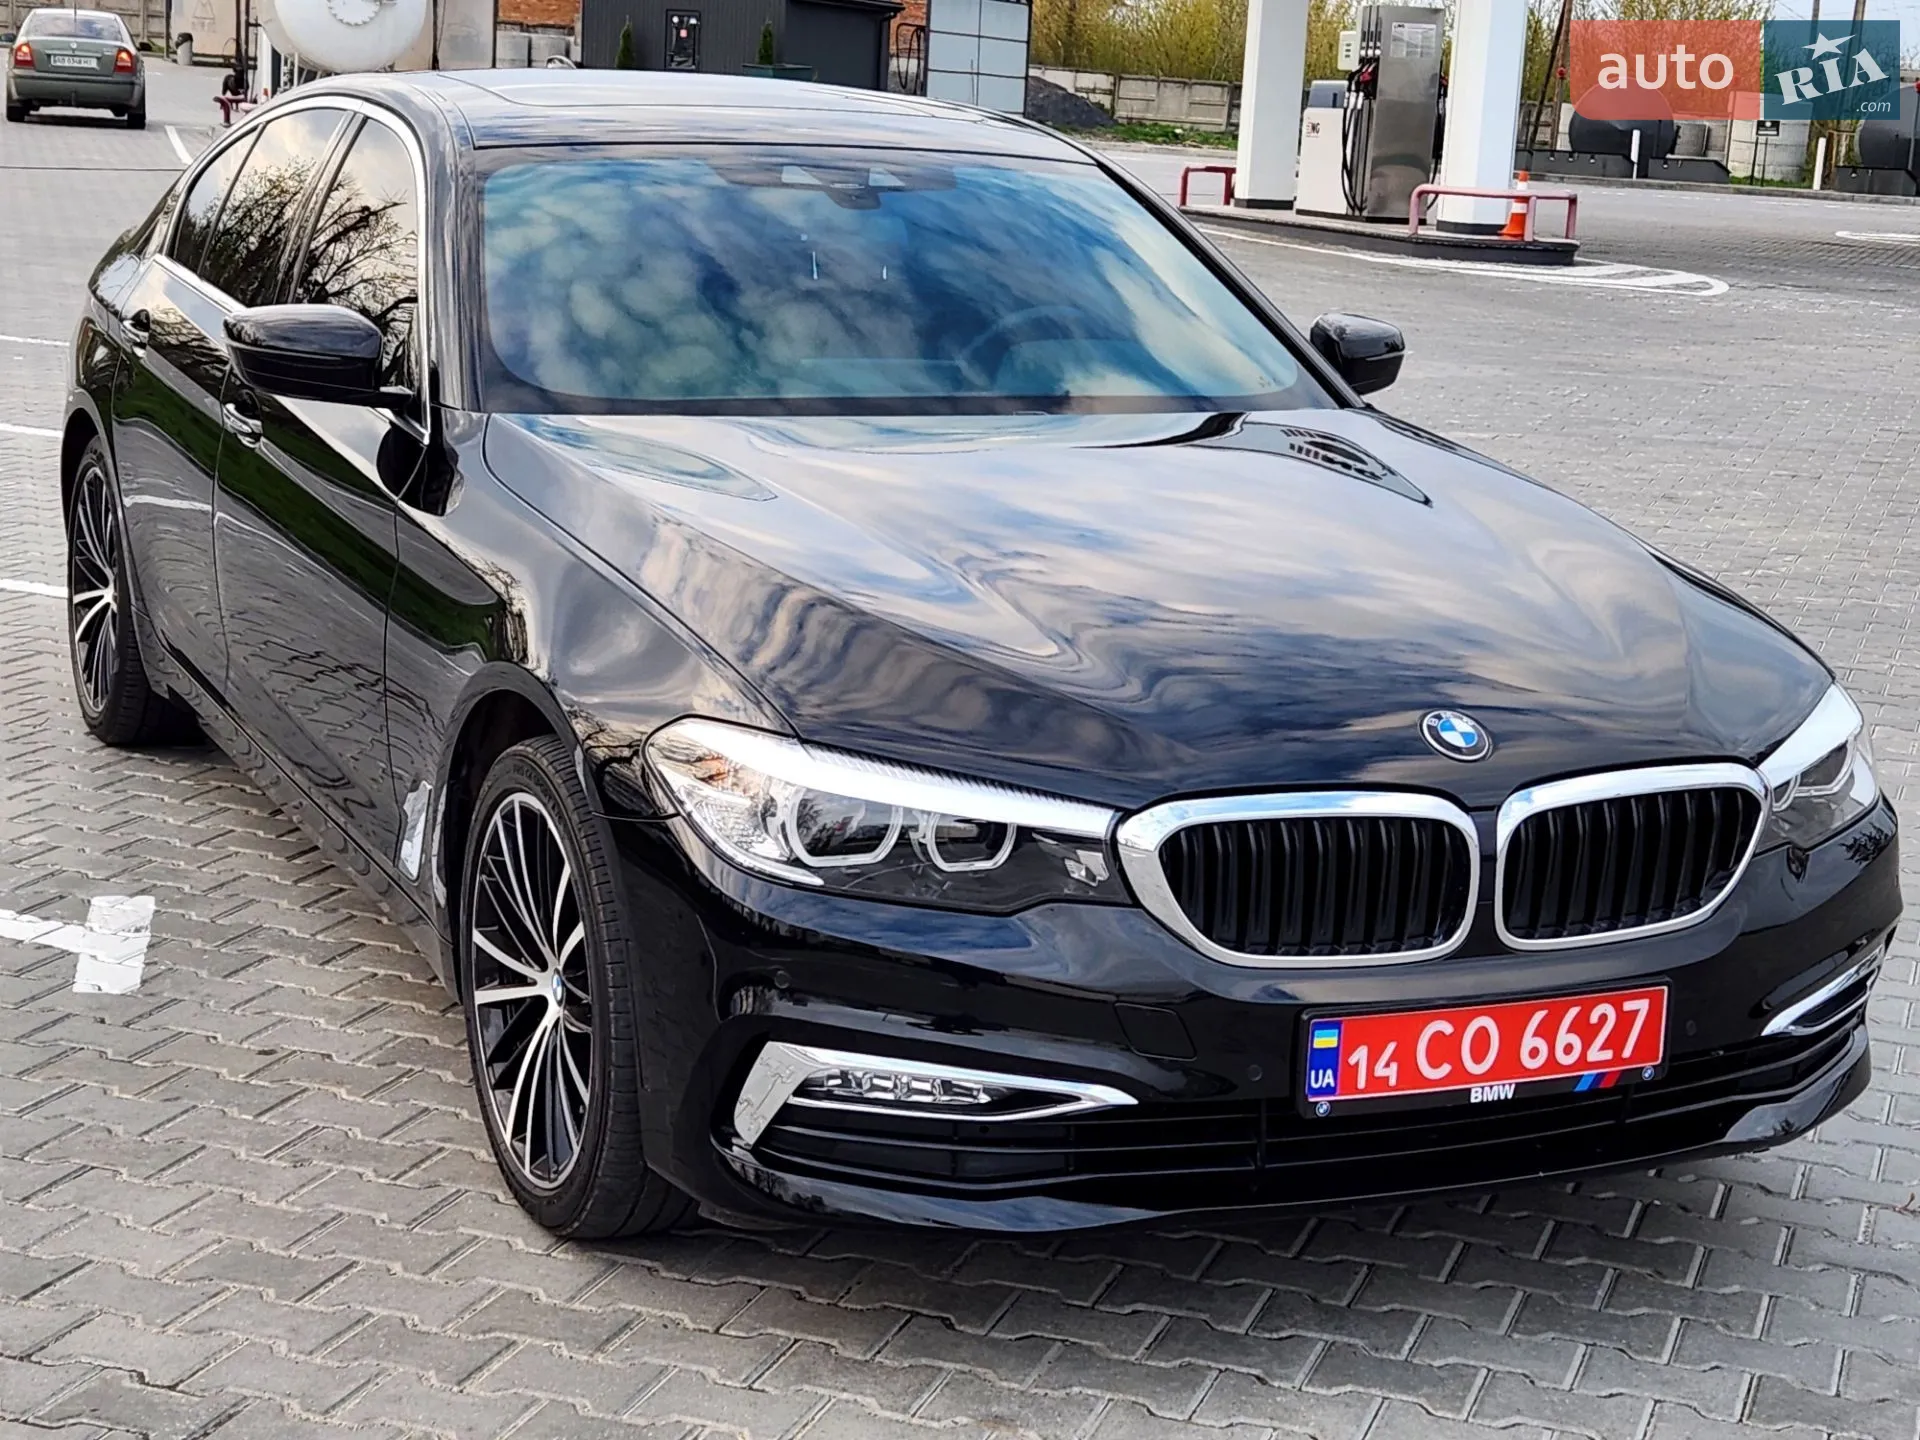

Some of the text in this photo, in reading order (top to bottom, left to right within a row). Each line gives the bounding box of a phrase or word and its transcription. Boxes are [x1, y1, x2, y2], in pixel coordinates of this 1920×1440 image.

[1347, 999, 1650, 1090] 14 CO 6627
[1310, 1068, 1336, 1089] UA
[1470, 1083, 1516, 1103] BMW
